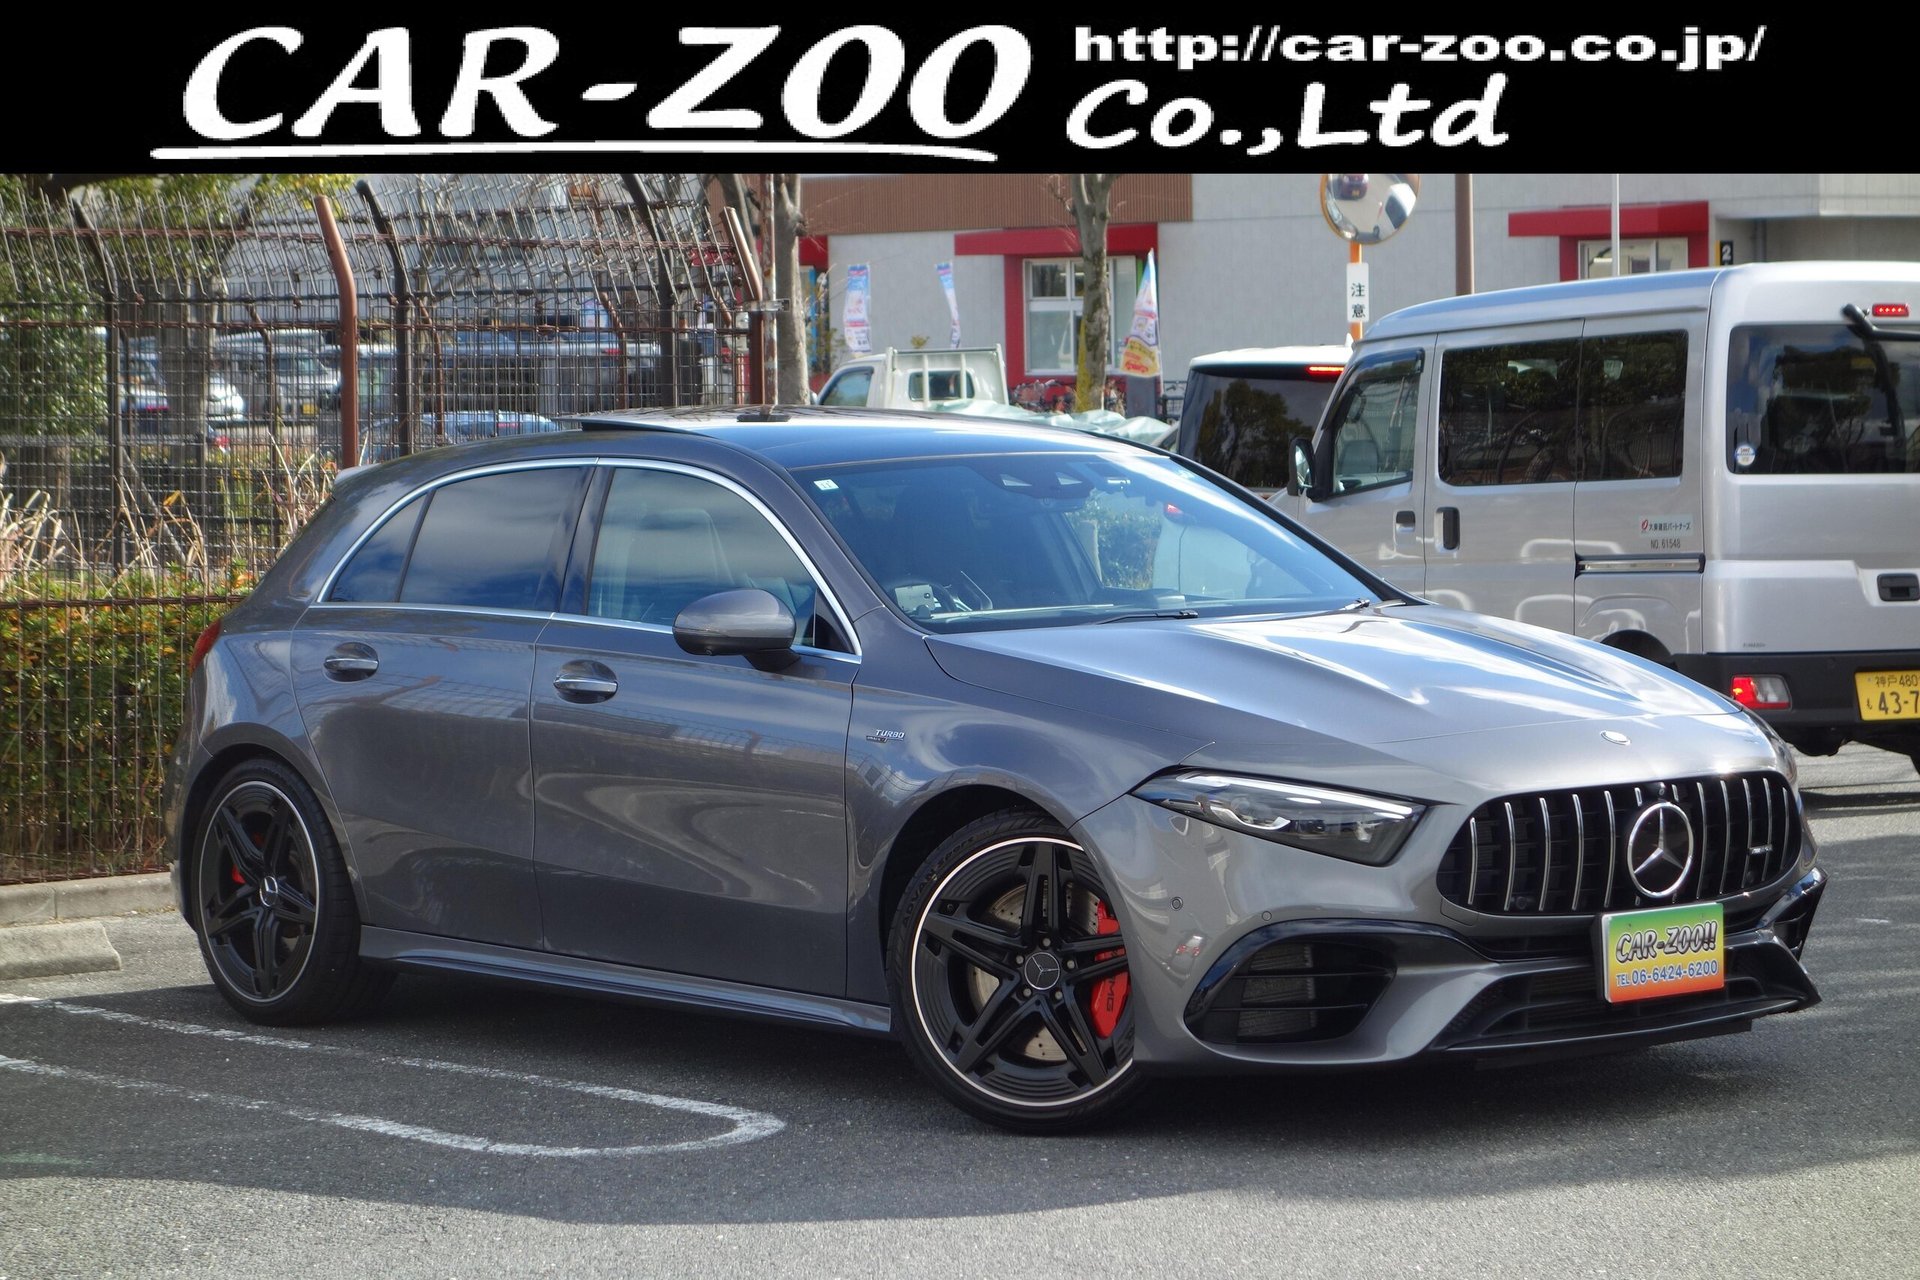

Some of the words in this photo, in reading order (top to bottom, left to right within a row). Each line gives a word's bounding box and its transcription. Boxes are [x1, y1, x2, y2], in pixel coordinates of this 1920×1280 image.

[1721, 244, 1732, 261] 2
[1350, 282, 1366, 318] 注意
[1899, 674, 1919, 687] 480
[875, 729, 905, 739] TURBO
[1615, 920, 1718, 963] CAR-ZOO!!
[1616, 973, 1630, 986] TEL
[1631, 959, 1718, 985] 06-6424-6200
